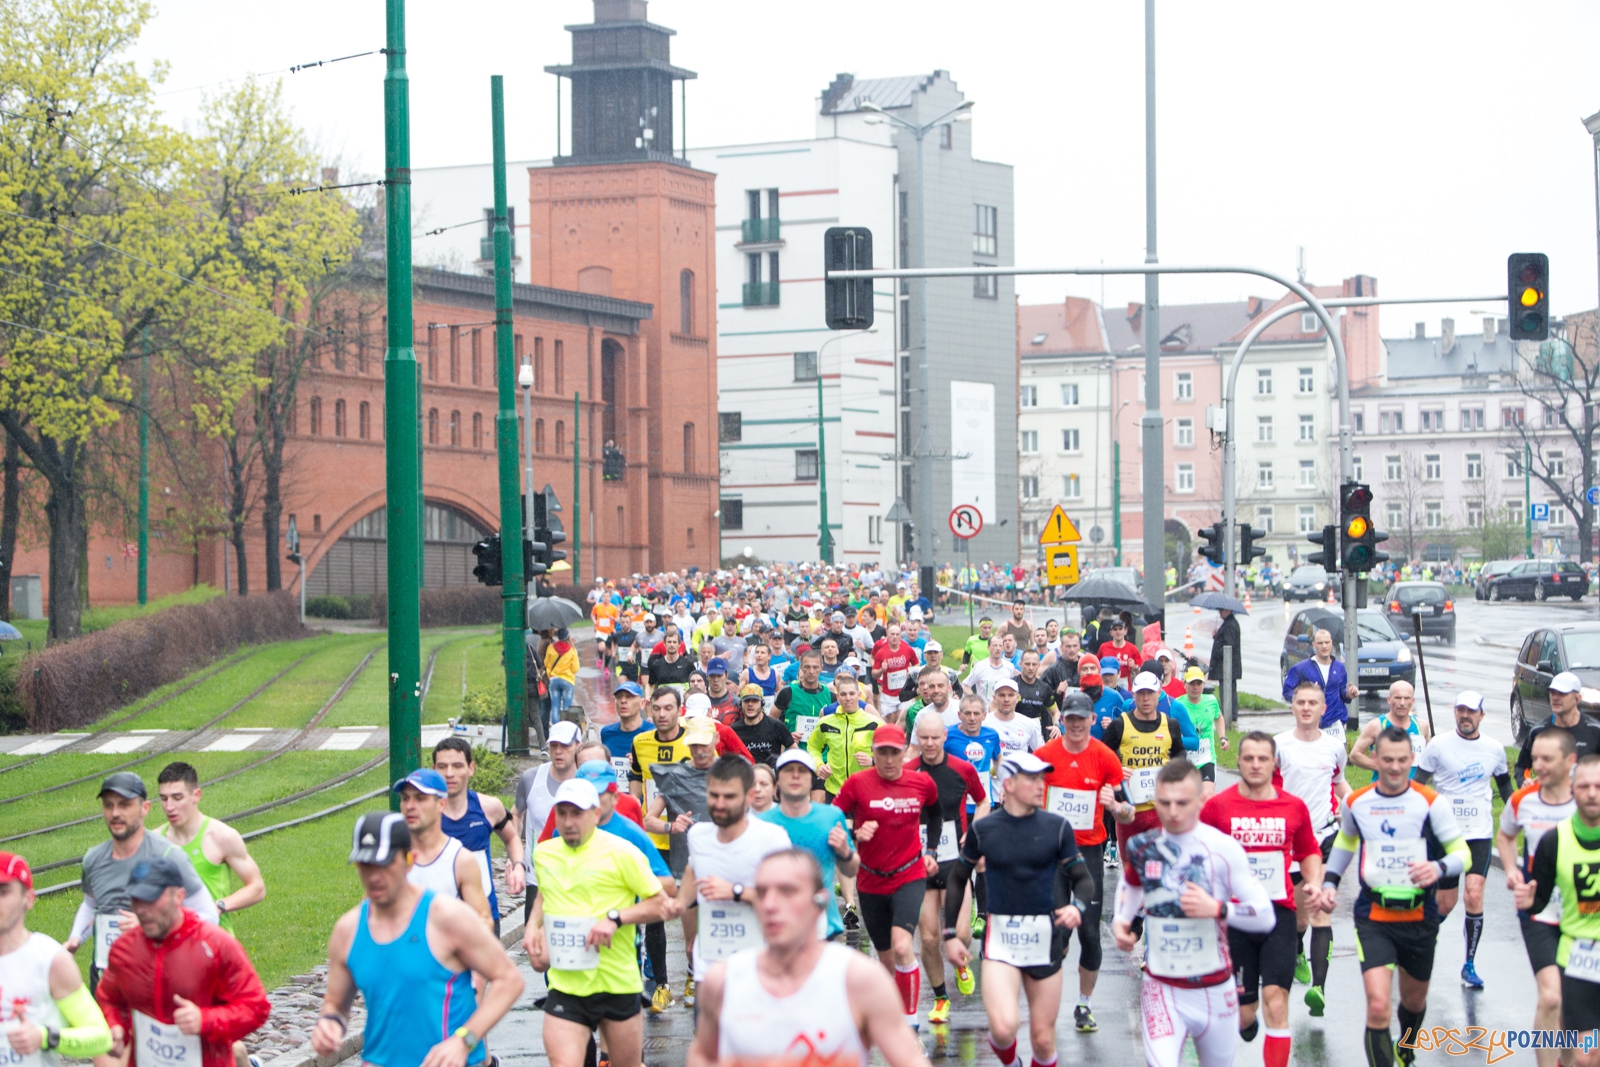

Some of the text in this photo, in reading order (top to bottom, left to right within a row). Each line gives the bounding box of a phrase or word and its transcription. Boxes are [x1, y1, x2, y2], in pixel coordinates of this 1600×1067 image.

[1132, 746, 1161, 755] GOCH
[1057, 800, 1089, 814] 2049
[1231, 816, 1286, 831] POLISH
[710, 922, 746, 938] 2319
[550, 932, 587, 948] 6333
[1000, 931, 1039, 946] 11894
[1159, 936, 1203, 952] 2573
[146, 1036, 187, 1061] 4202
